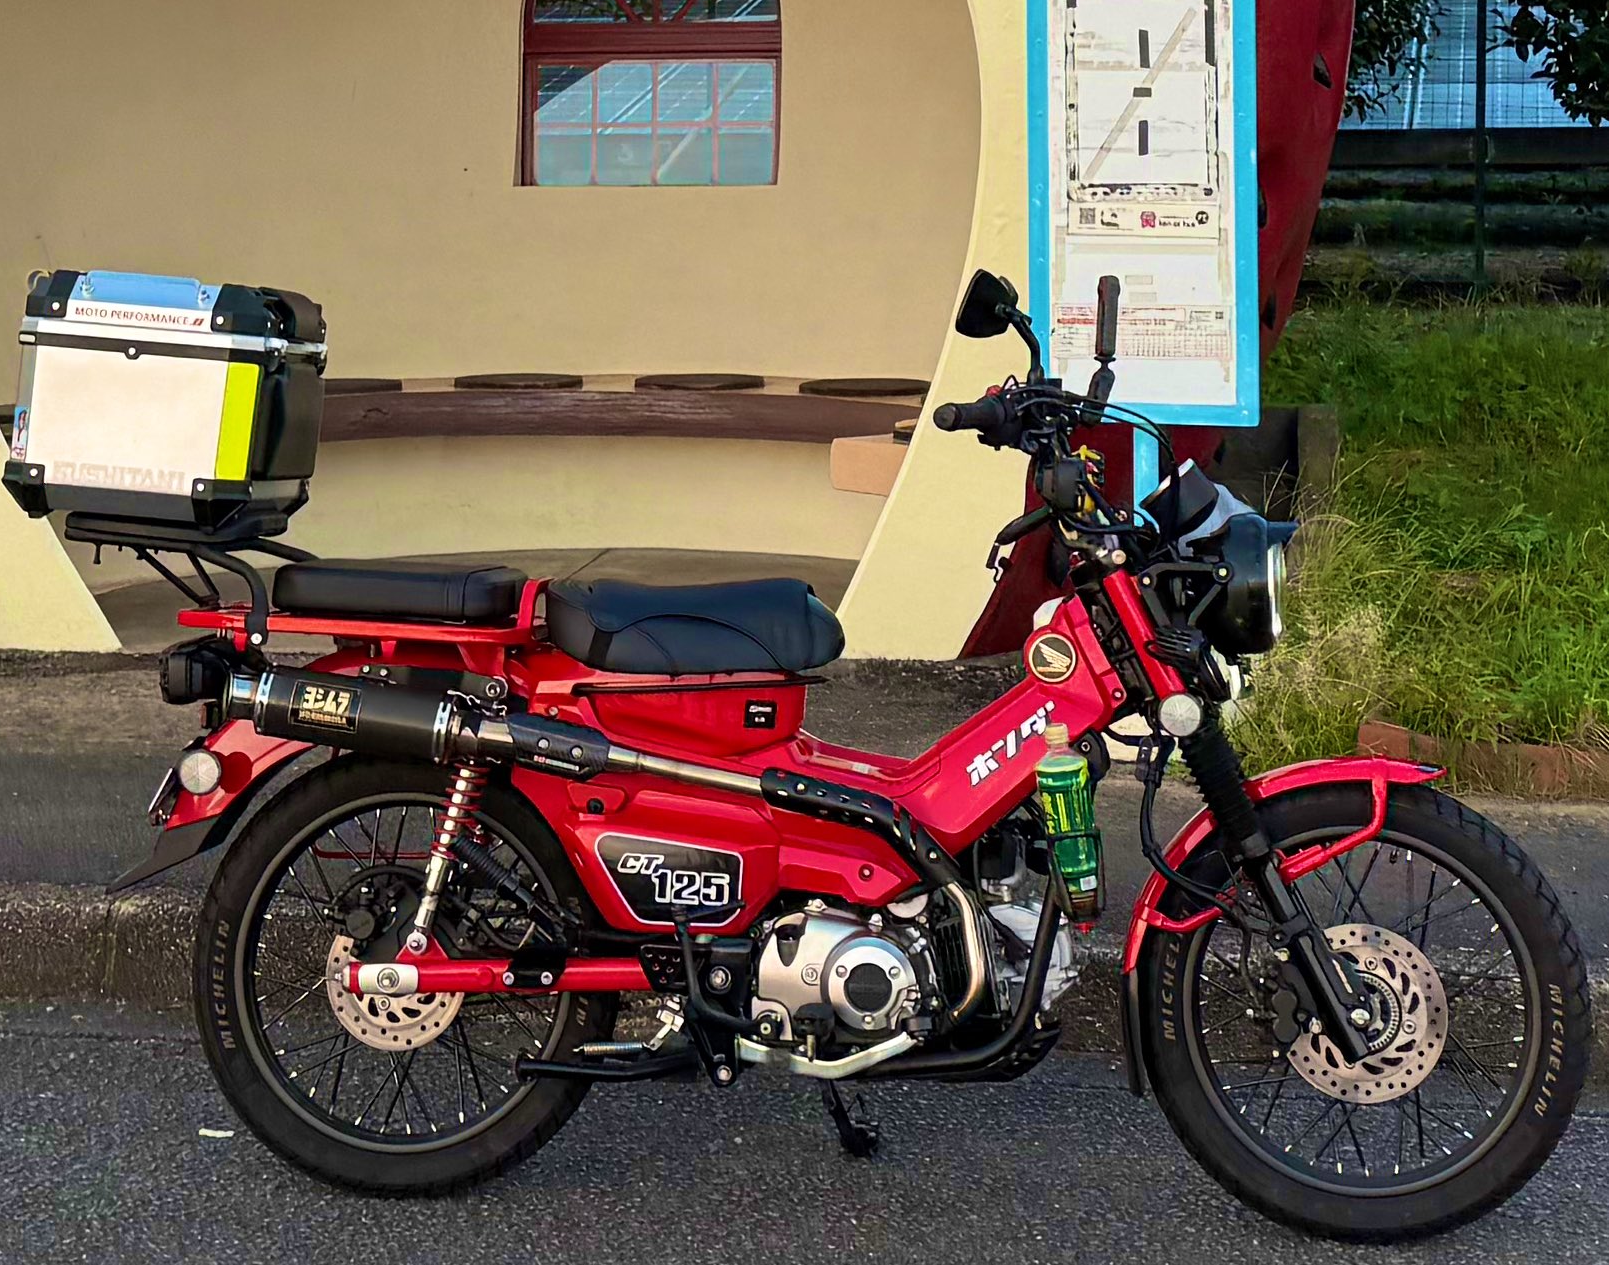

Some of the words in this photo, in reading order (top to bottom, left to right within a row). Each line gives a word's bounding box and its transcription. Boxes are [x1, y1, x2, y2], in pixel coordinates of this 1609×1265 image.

[75, 307, 108, 318] MOTO
[111, 310, 189, 326] PERFORMANCE
[302, 686, 351, 715] ヨシムラ
[617, 852, 665, 875] CT
[651, 868, 731, 906] 125
[212, 920, 237, 1049] MICHELIN
[1533, 983, 1565, 1118] MICHELIN
